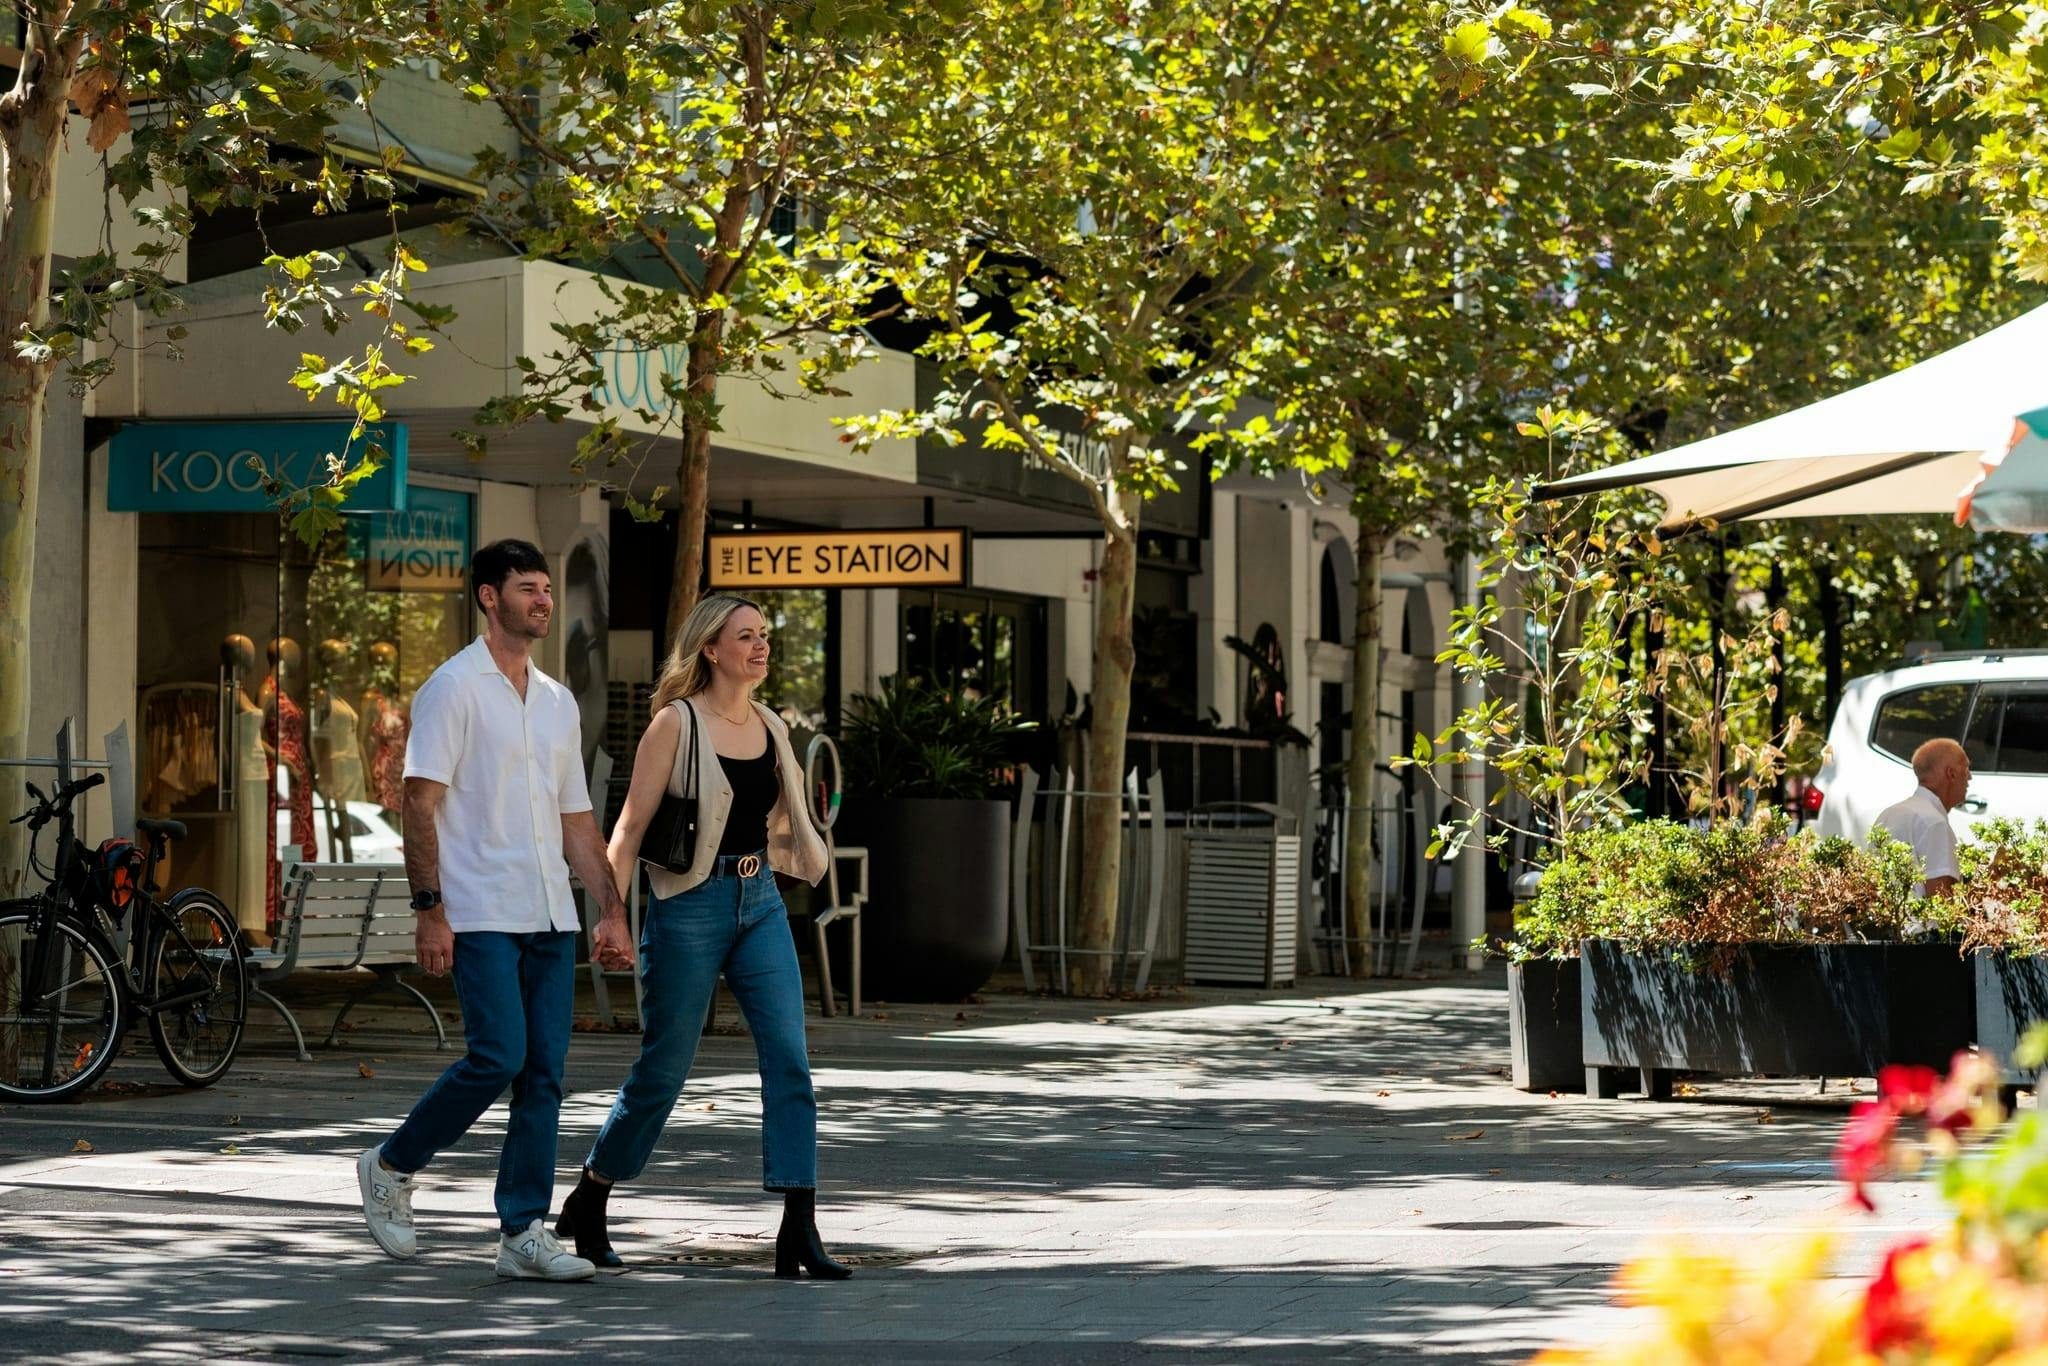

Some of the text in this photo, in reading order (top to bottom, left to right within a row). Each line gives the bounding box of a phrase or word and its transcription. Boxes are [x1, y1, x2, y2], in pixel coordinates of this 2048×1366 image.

[151, 450, 341, 493] KOOKA
[721, 546, 734, 575] THE
[747, 546, 802, 575] EYE
